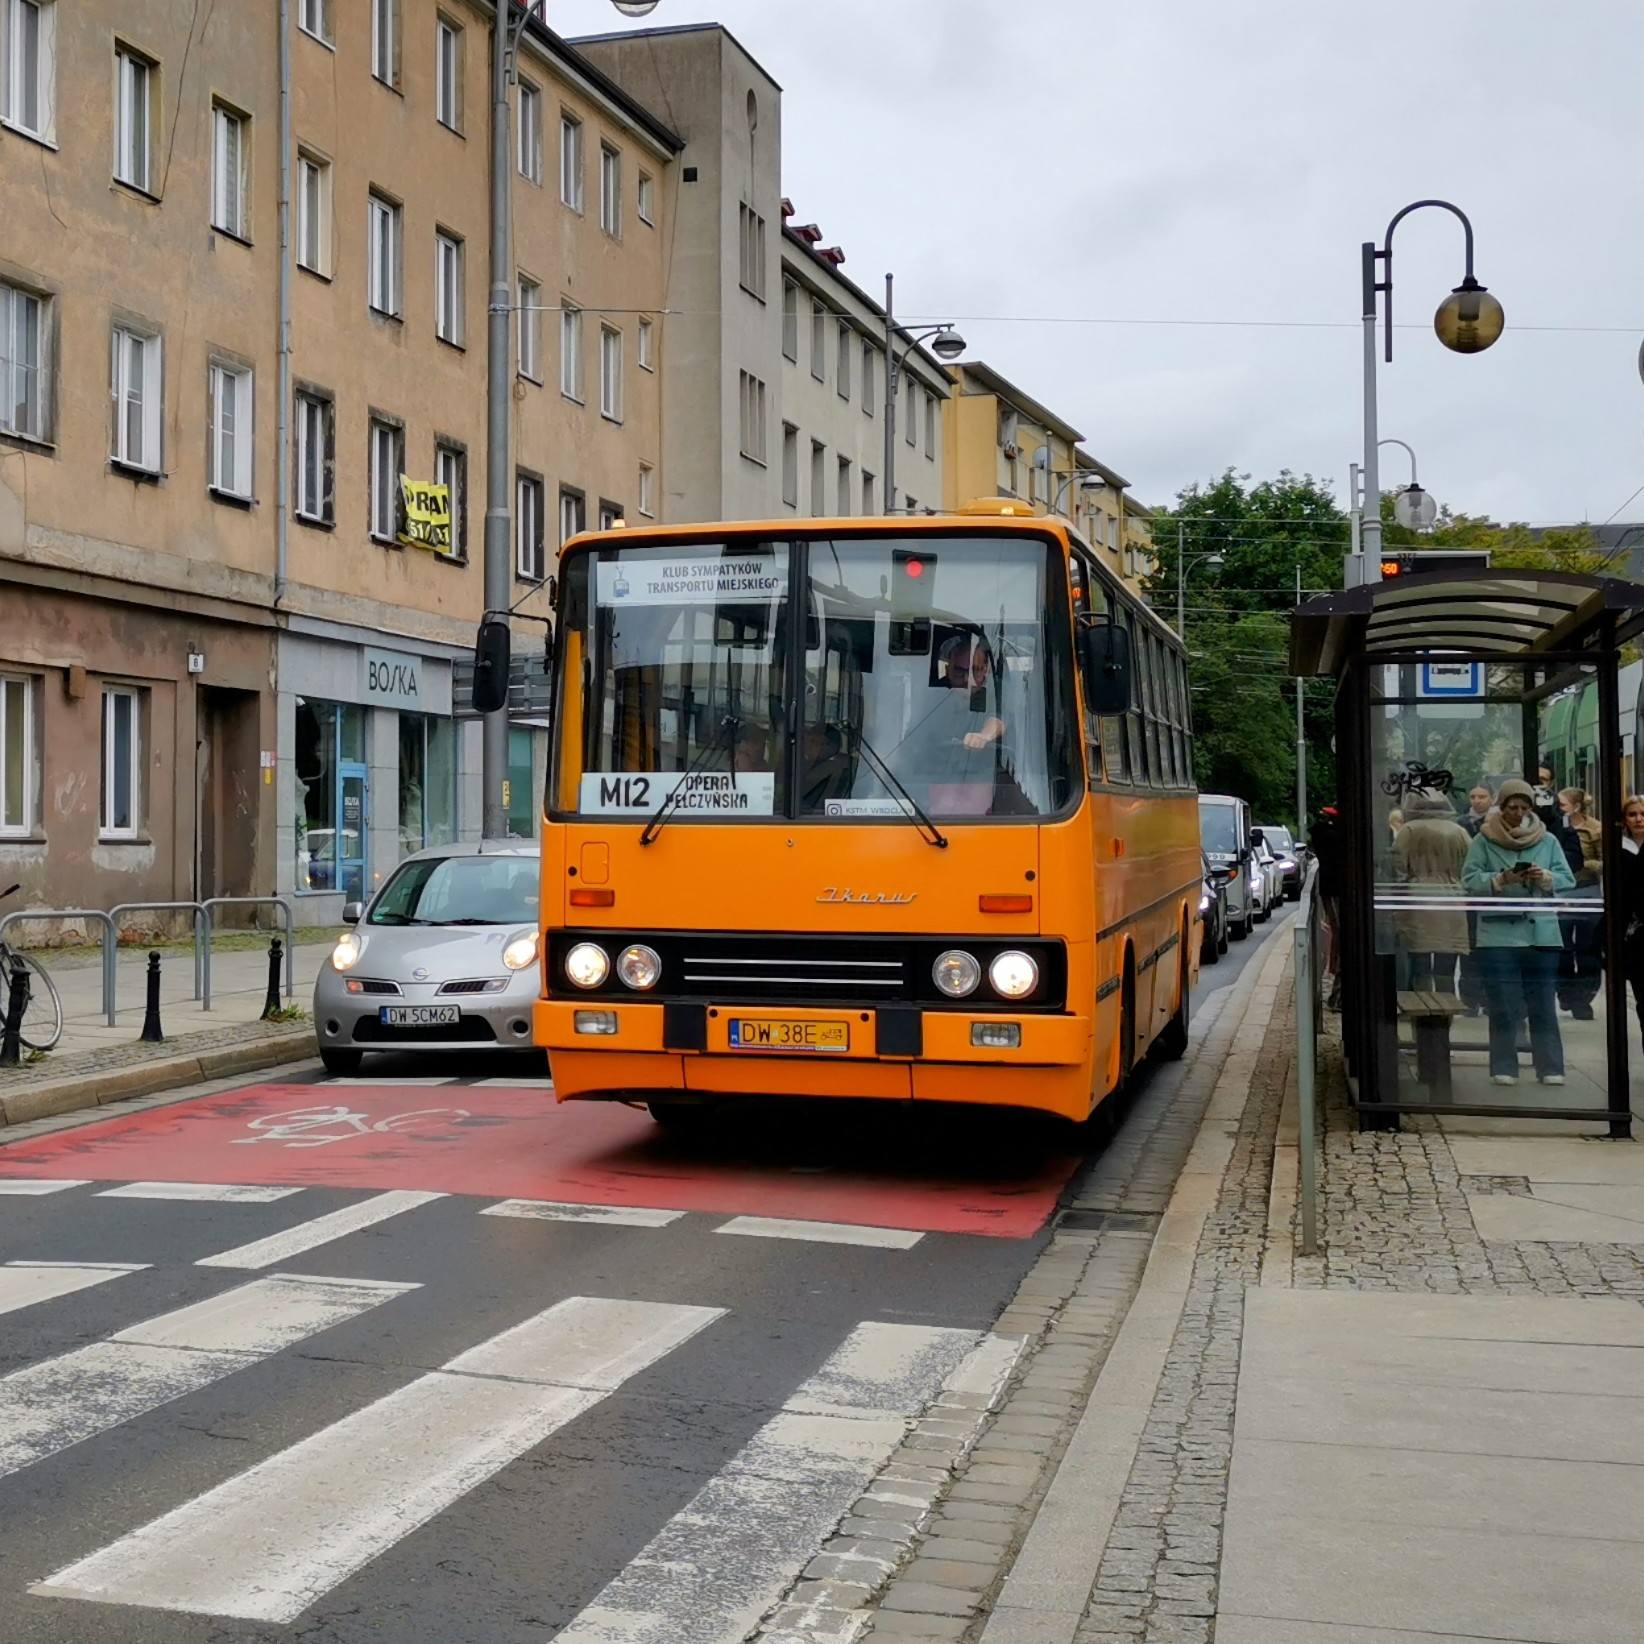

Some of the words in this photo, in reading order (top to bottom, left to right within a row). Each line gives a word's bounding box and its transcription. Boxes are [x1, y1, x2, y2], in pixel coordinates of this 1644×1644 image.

[662, 566, 689, 578] KLUB
[691, 563, 762, 577] SYMPATYKÓW
[647, 580, 714, 594] TRANSPORTU
[716, 577, 779, 591] MIEJSKIEGO
[368, 661, 418, 696] BOSKA
[686, 775, 729, 790] OPERA
[600, 777, 650, 807] M12
[665, 792, 748, 808] PEŁCZYŃSKA
[816, 887, 918, 904] Ikarus
[389, 1009, 407, 1023] DW
[412, 1007, 455, 1022] 5CM62
[742, 1023, 771, 1043] DW
[780, 1024, 817, 1044] 38E
